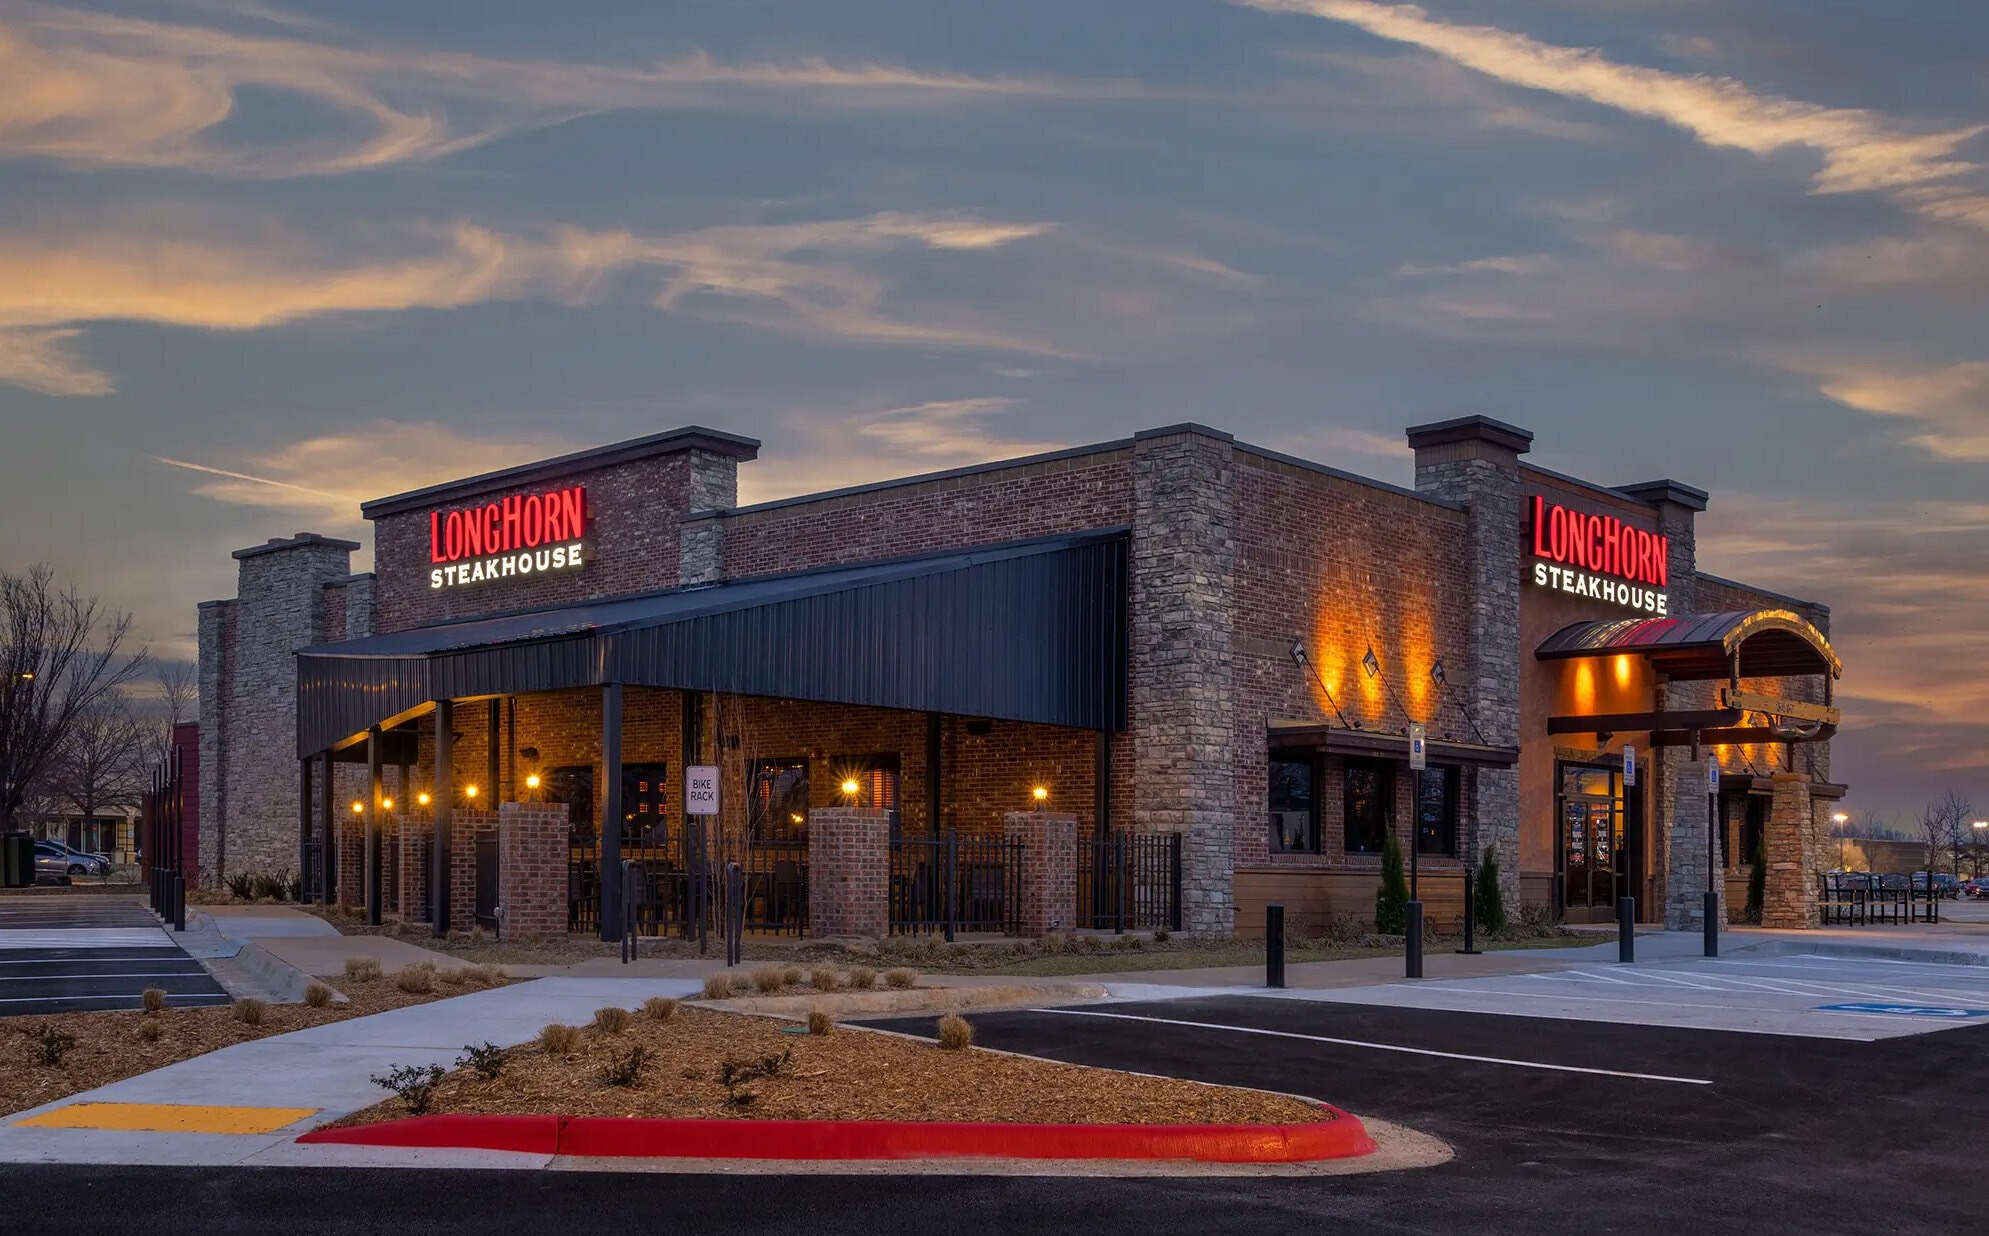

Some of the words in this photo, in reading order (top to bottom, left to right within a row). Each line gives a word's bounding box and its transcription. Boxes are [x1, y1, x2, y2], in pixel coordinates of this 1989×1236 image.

[430, 486, 585, 564] LONGHORN
[1533, 495, 1668, 587] LONGHORN
[430, 543, 582, 589] STEAKHOUSE
[1534, 563, 1668, 615] STEAKHOUSE
[690, 791, 714, 801] RACK
[692, 779, 712, 789] BIKE
